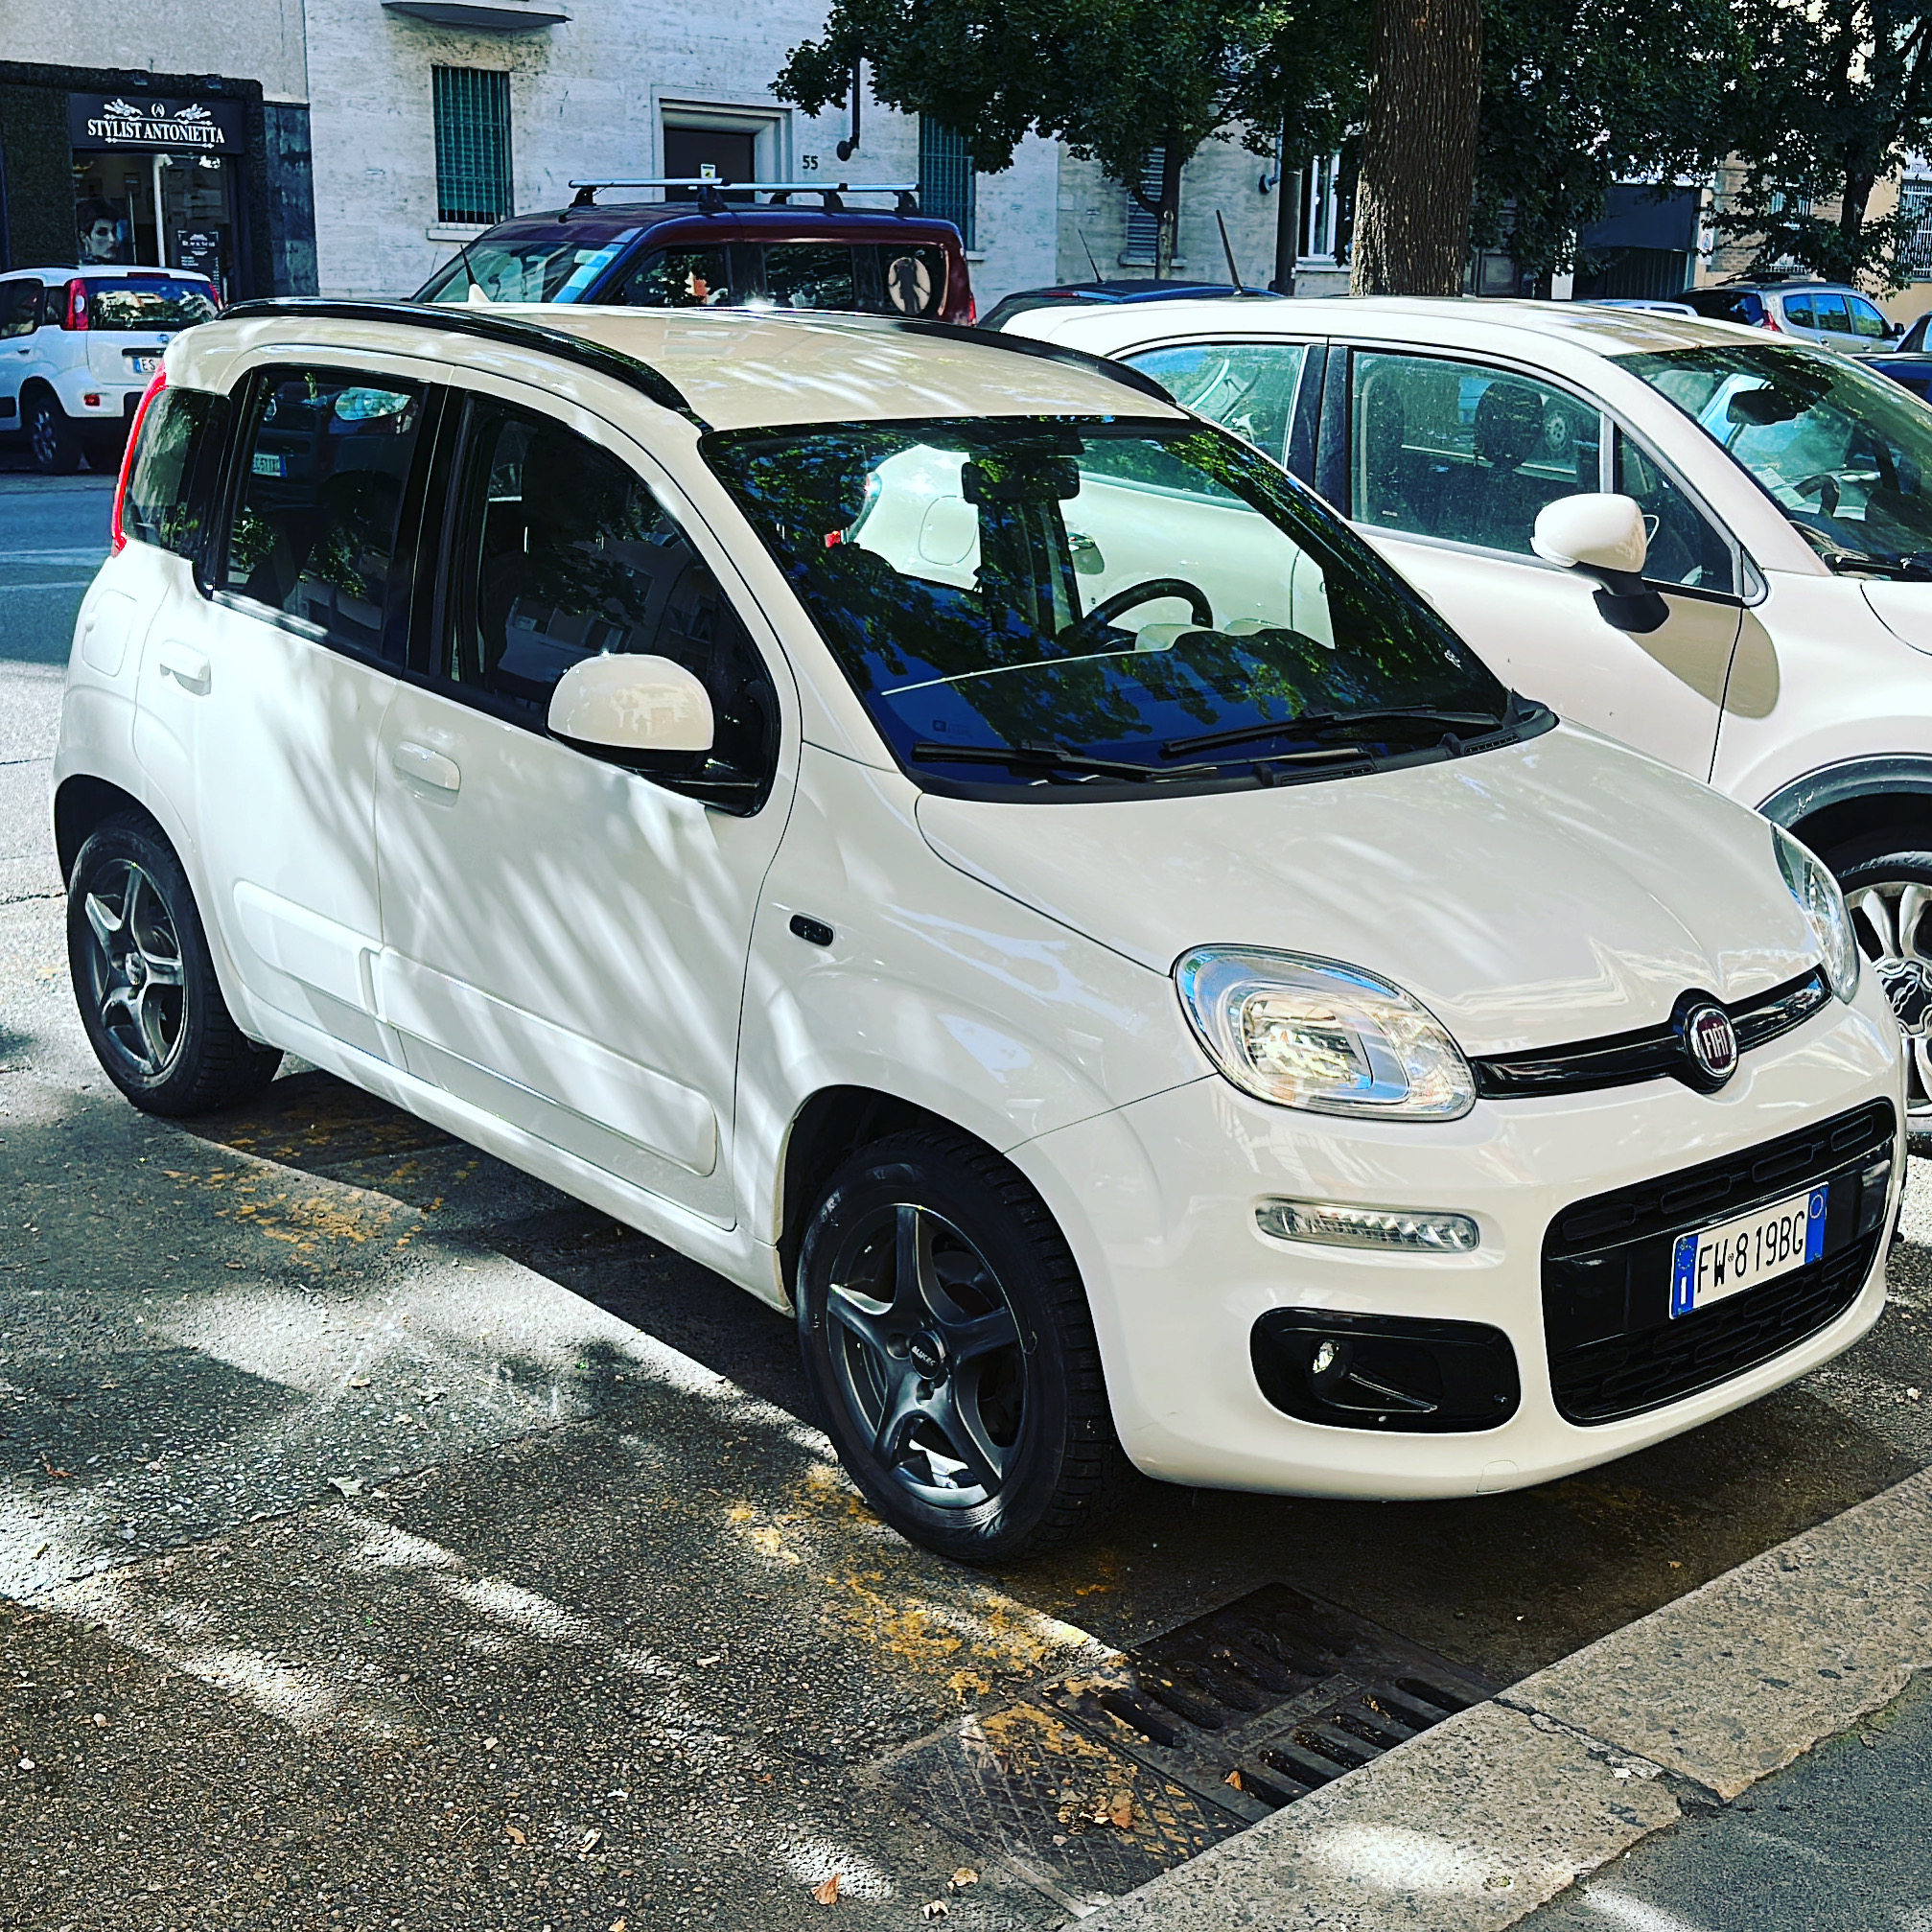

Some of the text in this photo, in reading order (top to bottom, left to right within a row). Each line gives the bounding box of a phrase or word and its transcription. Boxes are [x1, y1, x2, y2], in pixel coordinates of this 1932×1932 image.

[87, 119, 225, 144] STYLIST ANTONIETTA
[802, 154, 819, 171] 55
[1701, 1022, 1730, 1059] FIAT
